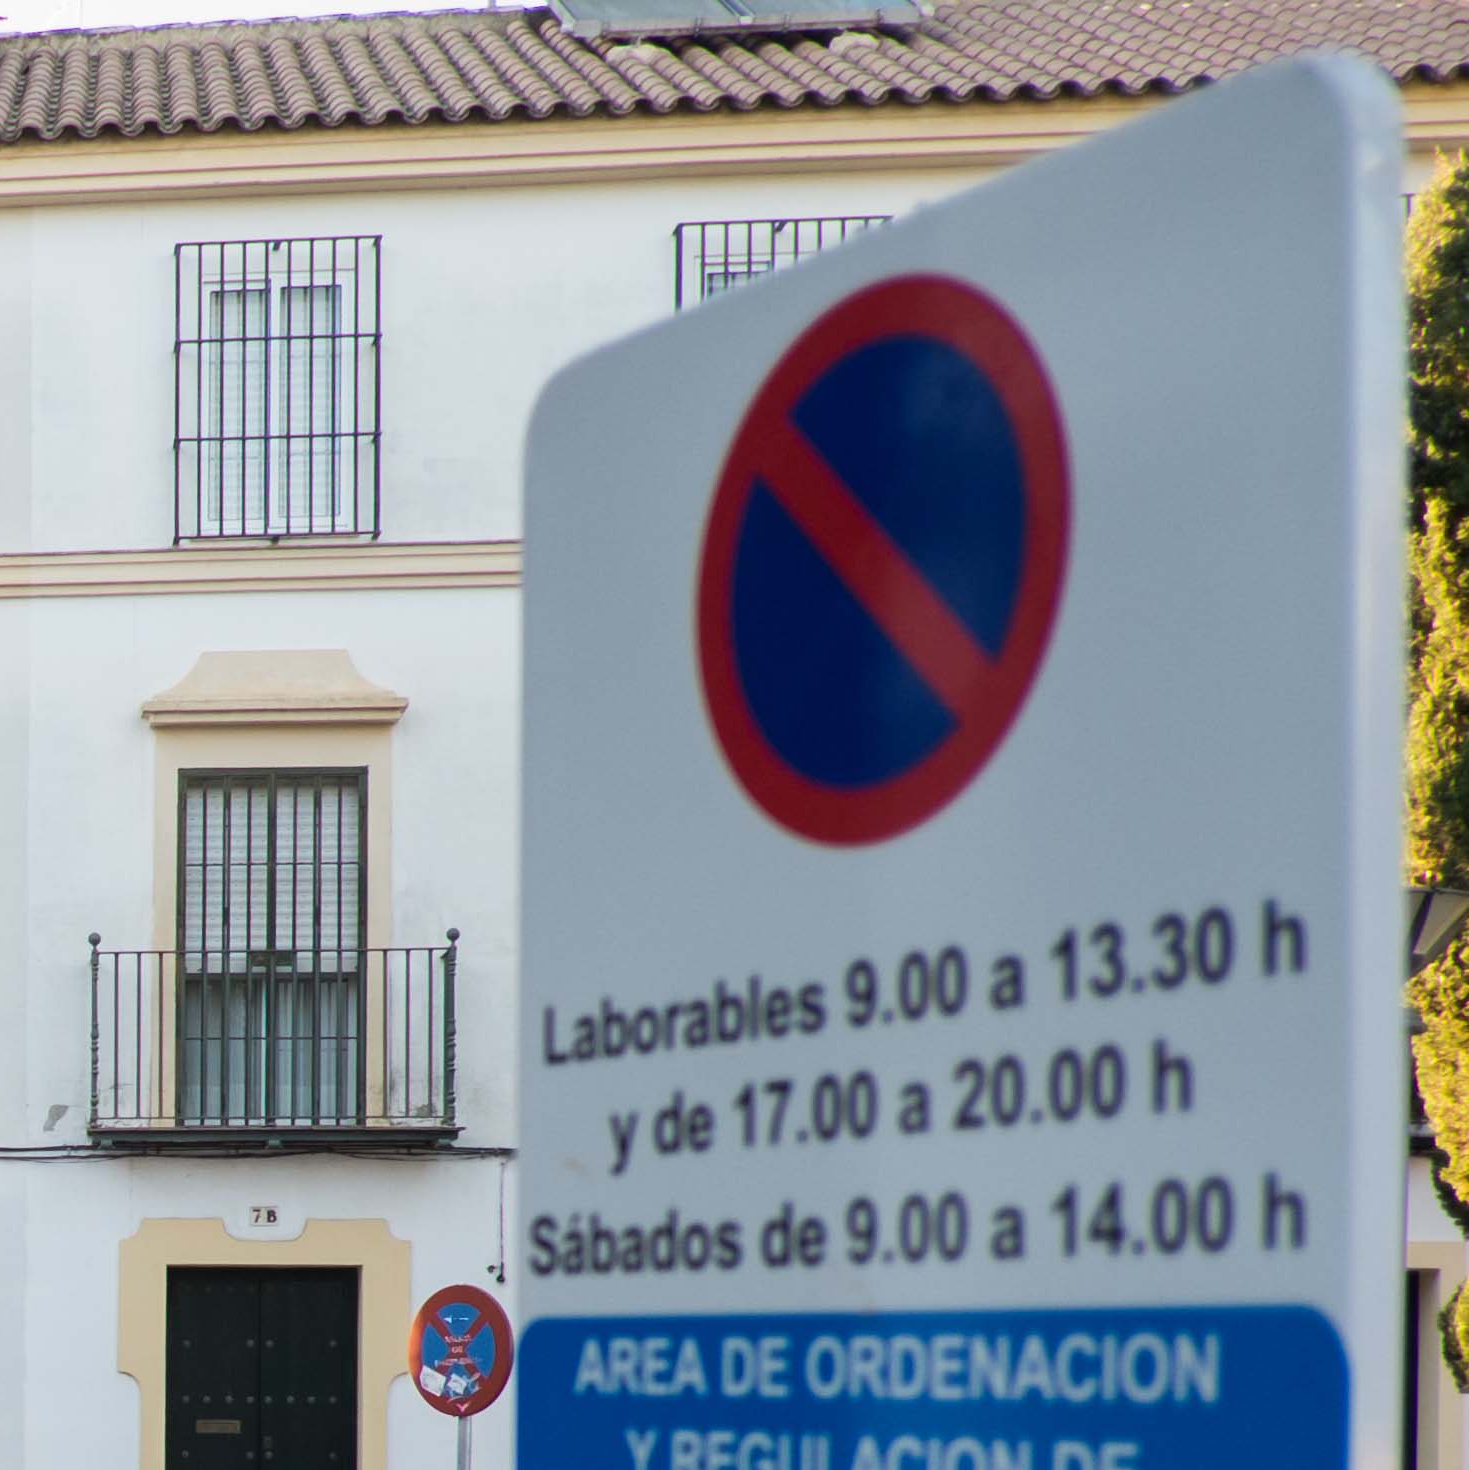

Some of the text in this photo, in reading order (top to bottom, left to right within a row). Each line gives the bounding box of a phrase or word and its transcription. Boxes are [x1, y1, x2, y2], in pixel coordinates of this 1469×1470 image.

[543, 898, 1308, 1067] Laborables 9.00 a 13.30 h
[608, 1038, 1194, 1177] y de 17.00 a 20.00 h
[529, 1171, 1307, 1277] Sábados de 9.00 a 14.00 h
[573, 1332, 1220, 1404] AREA DE ORDENACION
